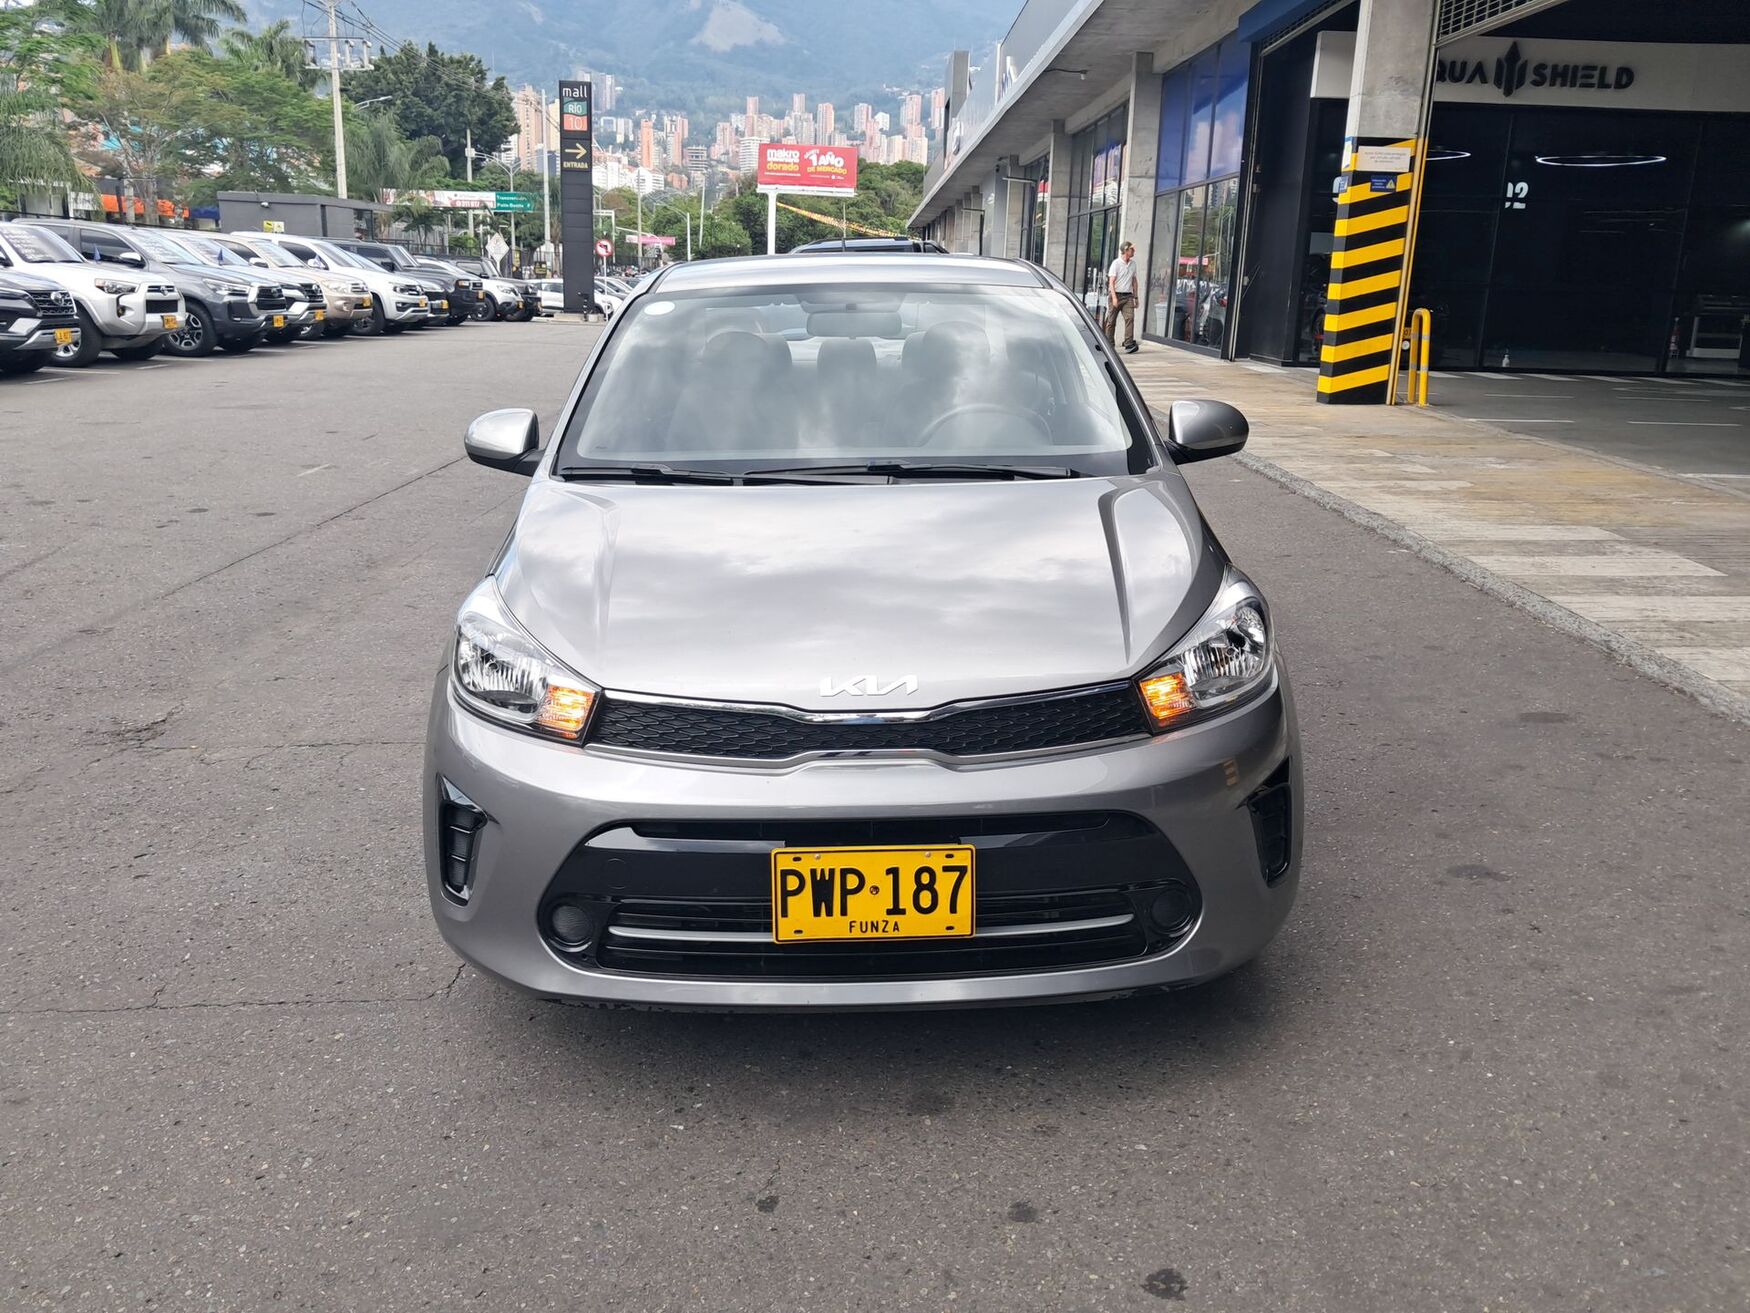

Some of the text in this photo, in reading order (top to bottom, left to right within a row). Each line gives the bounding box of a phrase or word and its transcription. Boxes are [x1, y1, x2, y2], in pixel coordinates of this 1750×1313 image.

[1530, 63, 1635, 90] SHIELD
[562, 85, 588, 98] mall
[570, 117, 583, 130] 10
[767, 148, 800, 159] makro
[767, 161, 800, 171] dorado
[819, 674, 919, 697] KIA
[779, 865, 969, 918] PWP 187
[849, 920, 900, 934] FUNZA
